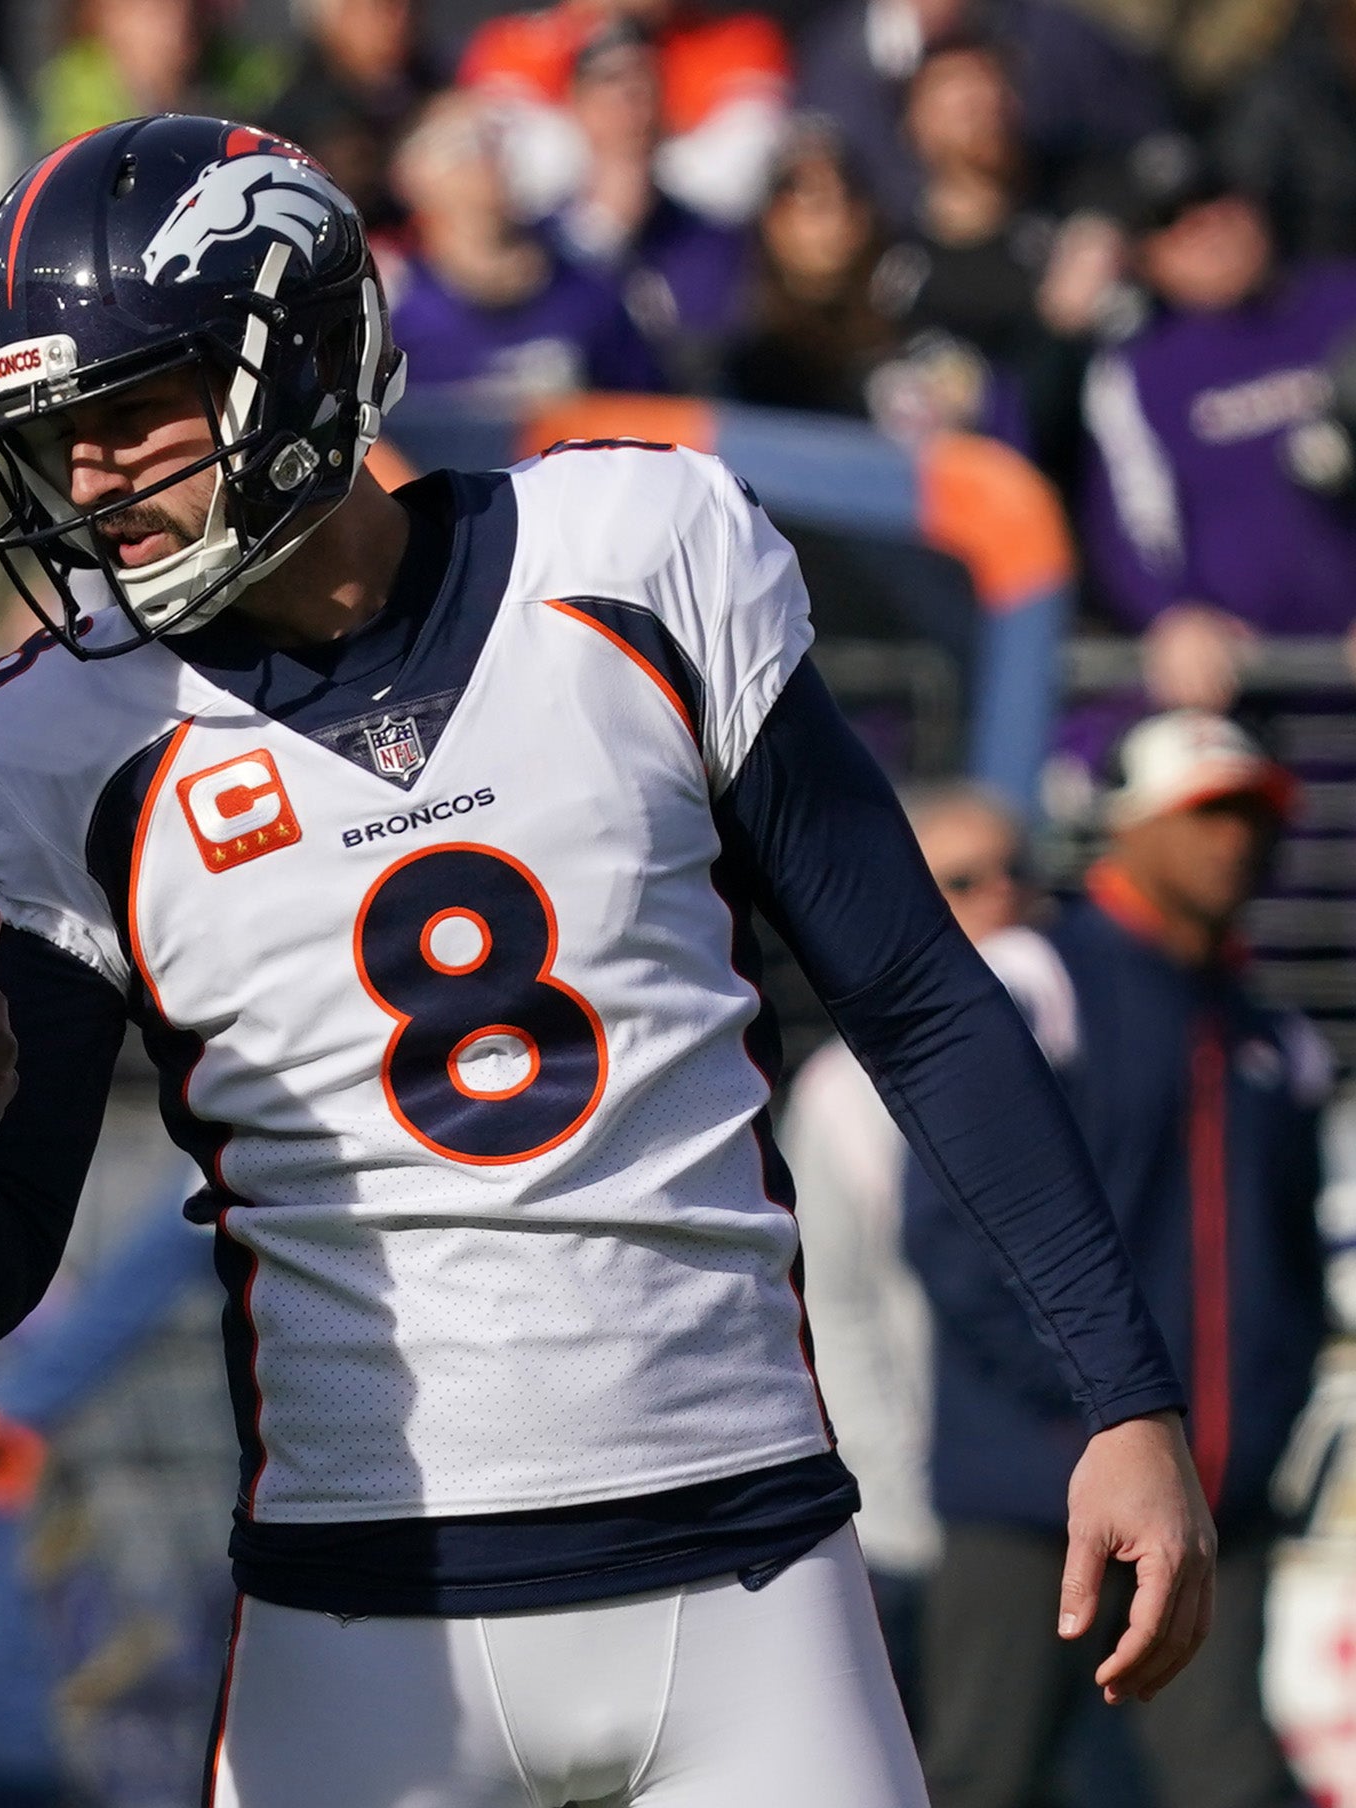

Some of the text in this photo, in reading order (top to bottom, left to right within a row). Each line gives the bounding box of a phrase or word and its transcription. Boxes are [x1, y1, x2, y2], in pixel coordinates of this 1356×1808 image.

[380, 742, 417, 769] NFL
[188, 761, 282, 844] C
[342, 787, 496, 848] BRONCOS
[353, 841, 609, 1165] 8
